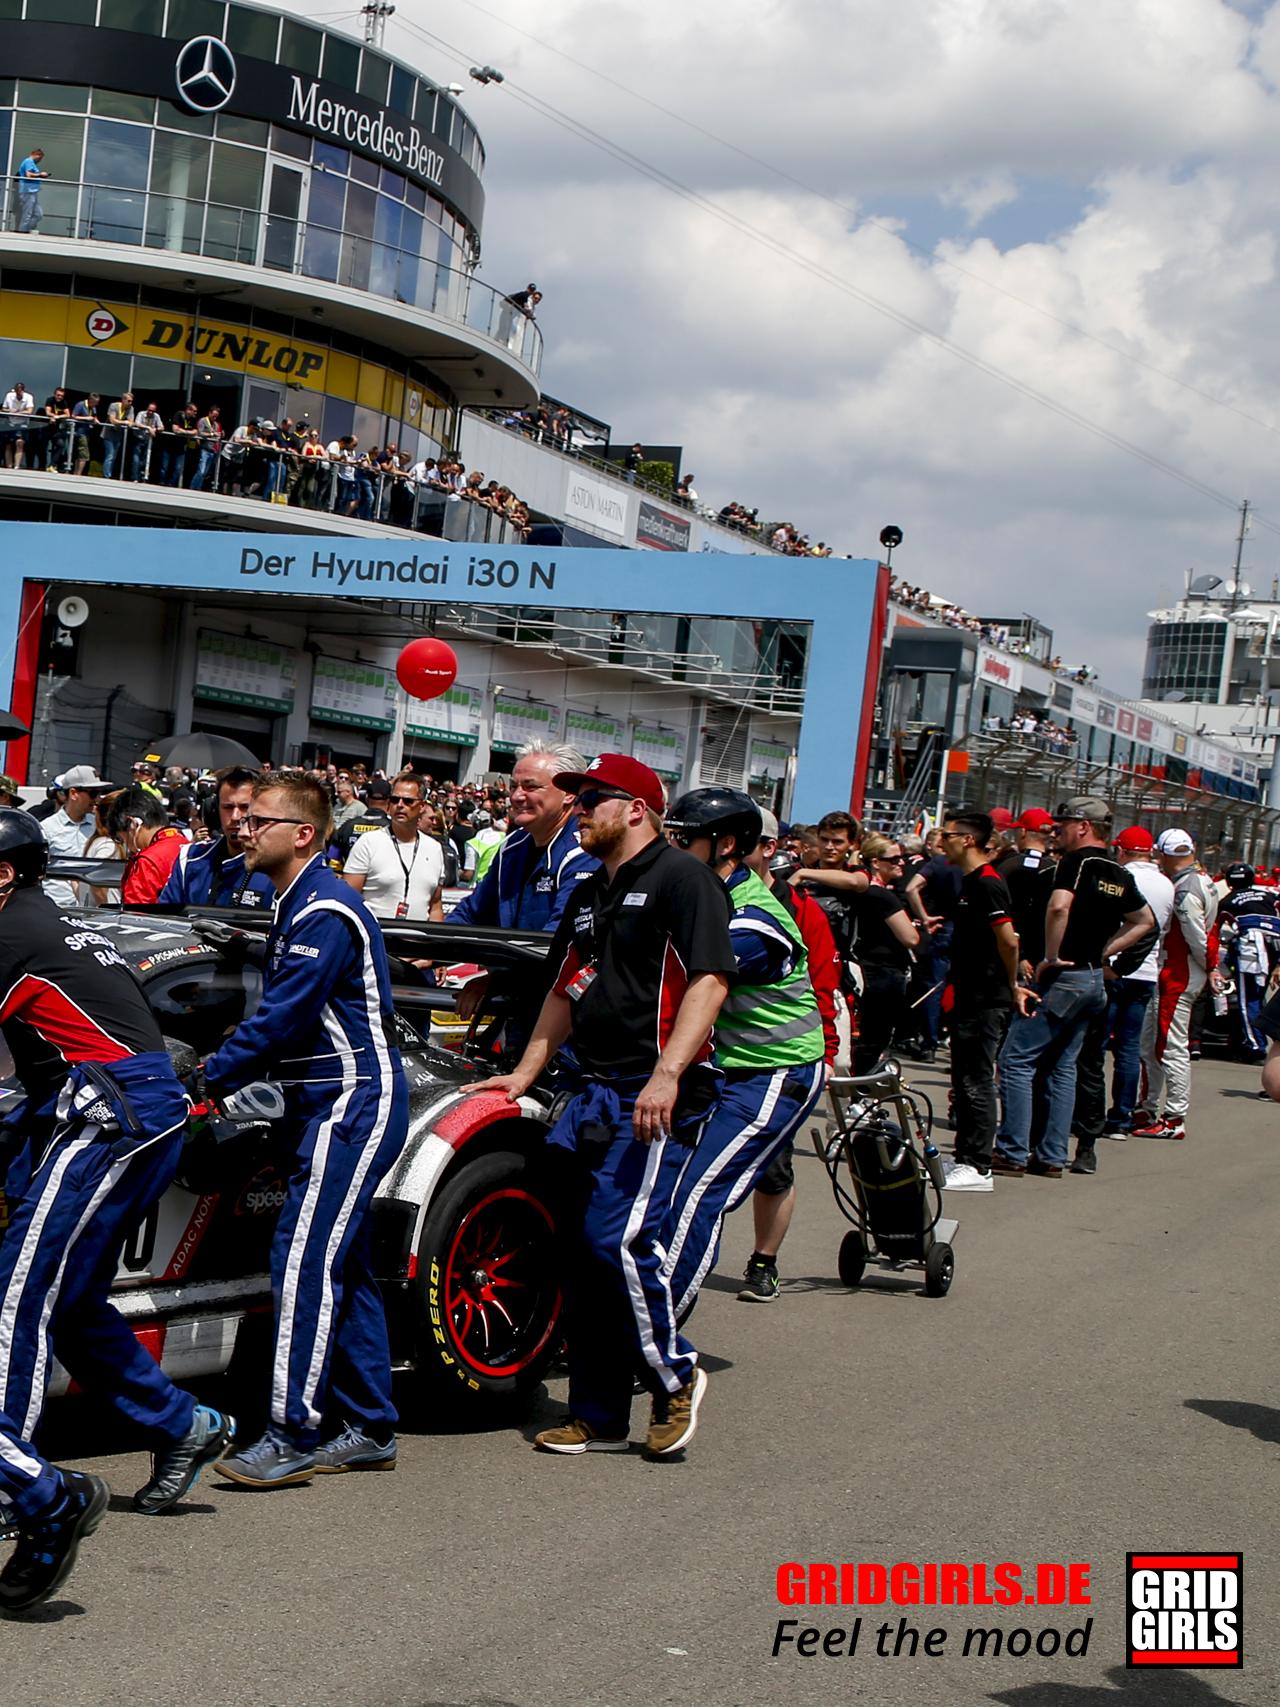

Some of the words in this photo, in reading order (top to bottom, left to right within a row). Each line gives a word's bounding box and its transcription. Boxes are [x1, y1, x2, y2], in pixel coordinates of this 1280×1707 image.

[287, 75, 445, 186] Mercedes-Benz
[141, 319, 324, 379] DUNLOP
[239, 548, 296, 577] Der
[311, 551, 450, 586] Hyundai
[466, 556, 520, 589] i30
[528, 561, 557, 590] N
[1098, 879, 1125, 897] CREW
[172, 1230, 198, 1275] ADAC
[197, 1193, 213, 1229] NOR
[429, 1262, 446, 1344] ZERO
